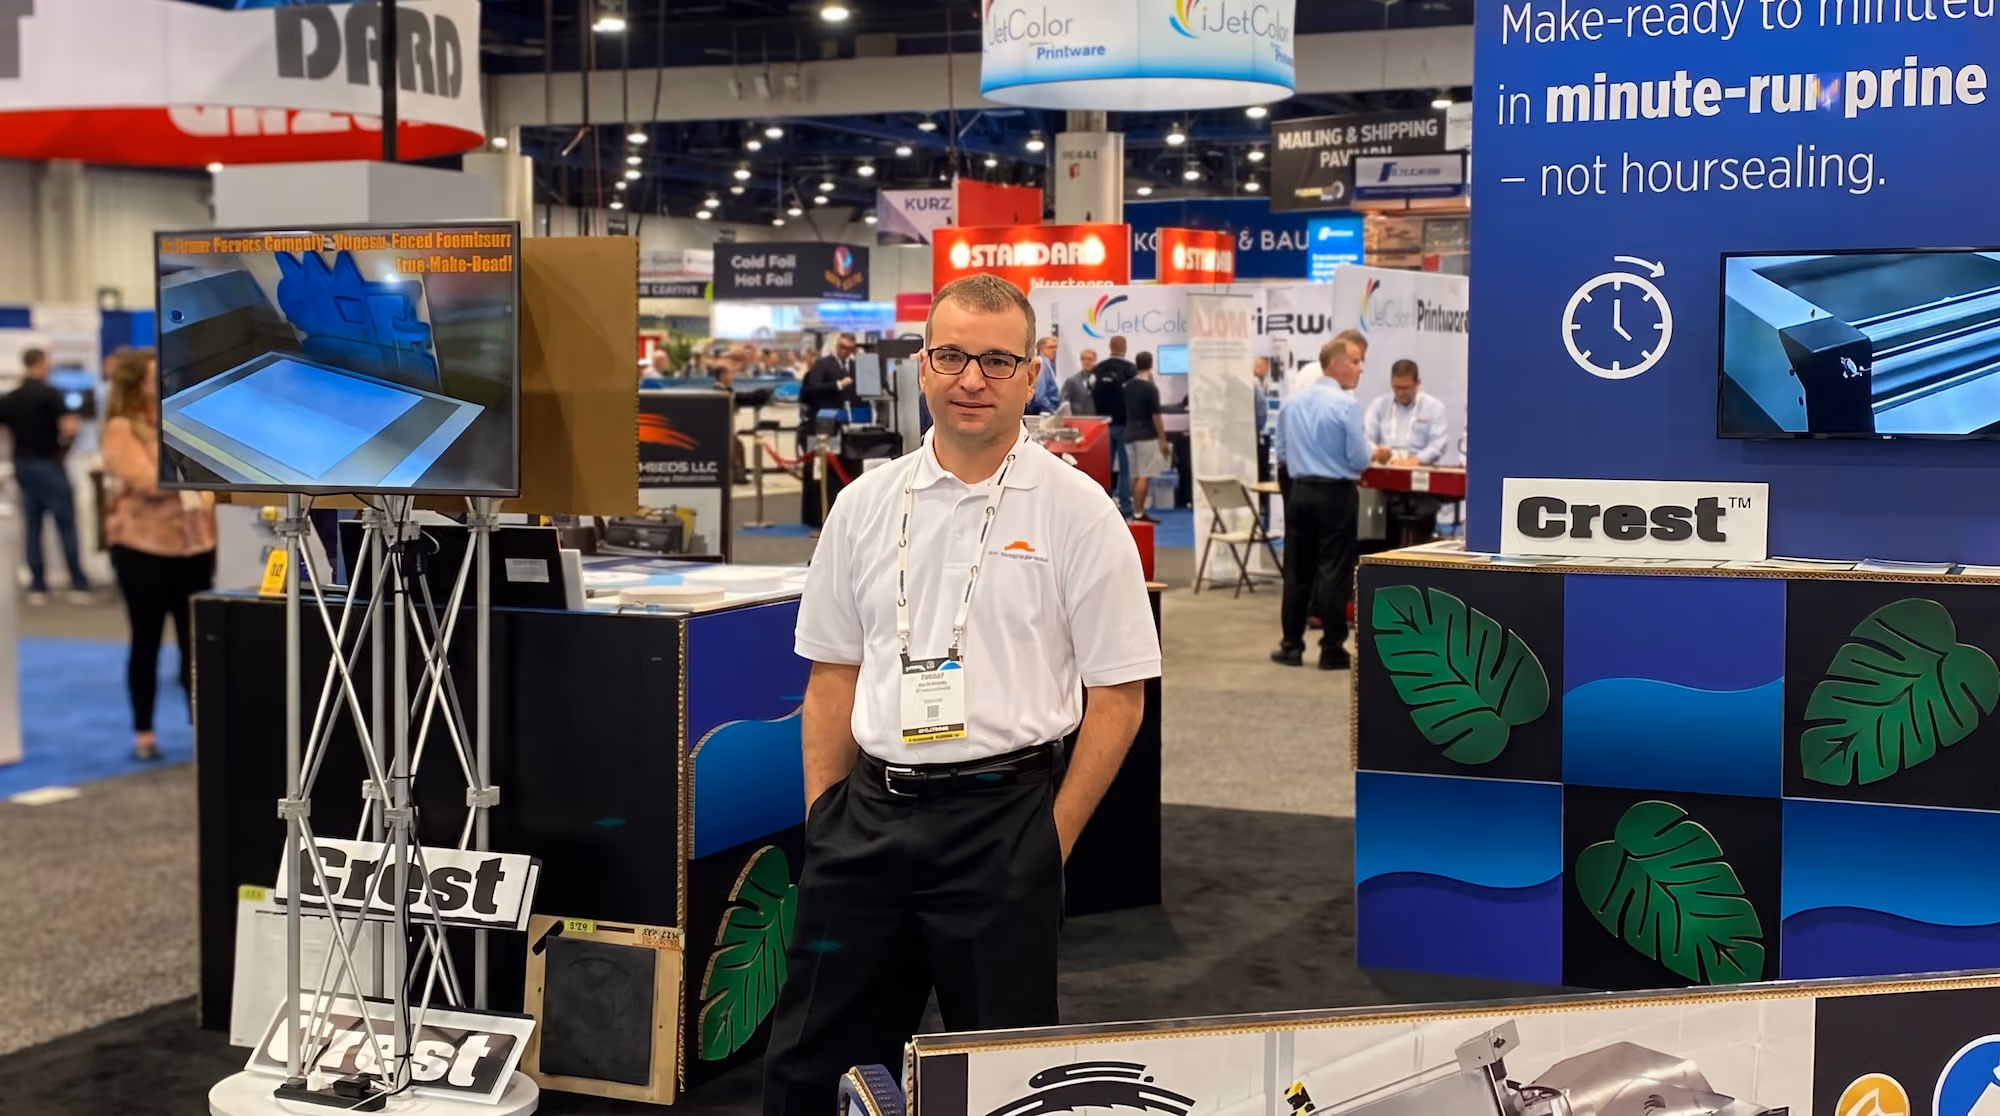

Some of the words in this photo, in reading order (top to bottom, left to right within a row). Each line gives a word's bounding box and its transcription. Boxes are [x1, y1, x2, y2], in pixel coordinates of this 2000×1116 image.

[1502, 0, 1744, 45] Make-ready
[1760, 0, 1802, 30] to
[1036, 45, 1106, 60] Printware
[1498, 83, 1531, 125] in
[1844, 55, 1988, 119] prine
[1278, 128, 1342, 149] MAILING
[1346, 126, 1357, 143] &
[1361, 119, 1438, 142] SHIPPING
[1541, 155, 1607, 196] not
[1622, 144, 1886, 195] hoursealing.
[905, 197, 952, 210] KURZ
[1239, 230, 1255, 250] &
[731, 255, 765, 269] Cold
[769, 254, 796, 268] Foil
[735, 273, 761, 287] Hot
[766, 272, 793, 286] Foil
[691, 462, 718, 473] LLC
[1517, 496, 1726, 542] Crest
[299, 846, 505, 915] Crest
[267, 1014, 491, 1087] Crest
